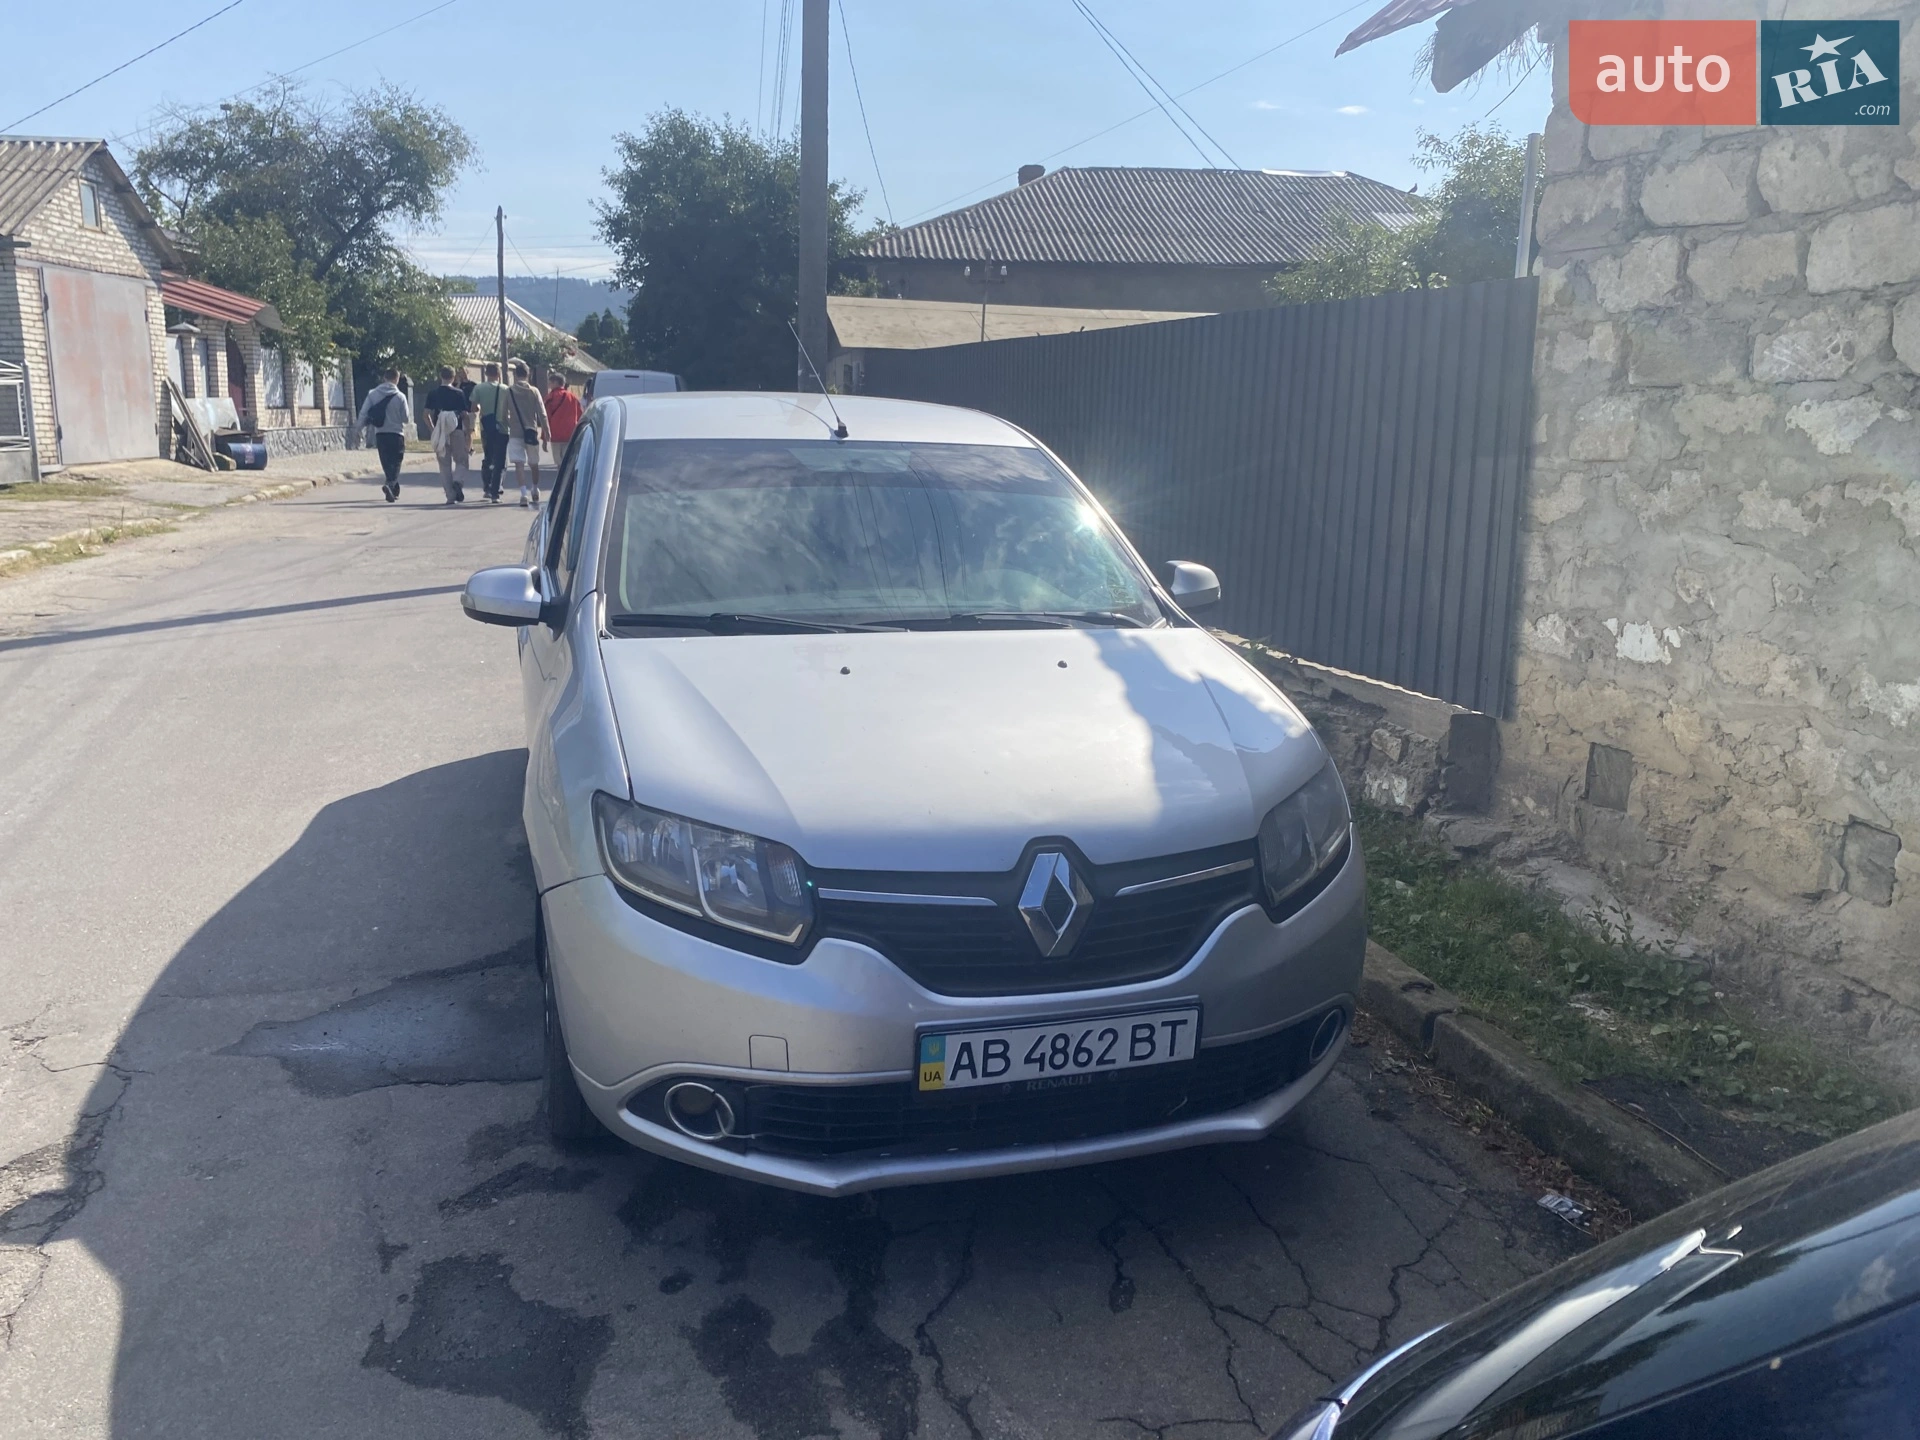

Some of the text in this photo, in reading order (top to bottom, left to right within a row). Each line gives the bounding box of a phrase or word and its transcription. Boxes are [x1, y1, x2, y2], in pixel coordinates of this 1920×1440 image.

[949, 1019, 1188, 1081] AB 4862 BT
[923, 1071, 942, 1083] UA
[1026, 1074, 1093, 1091] RENAULT
